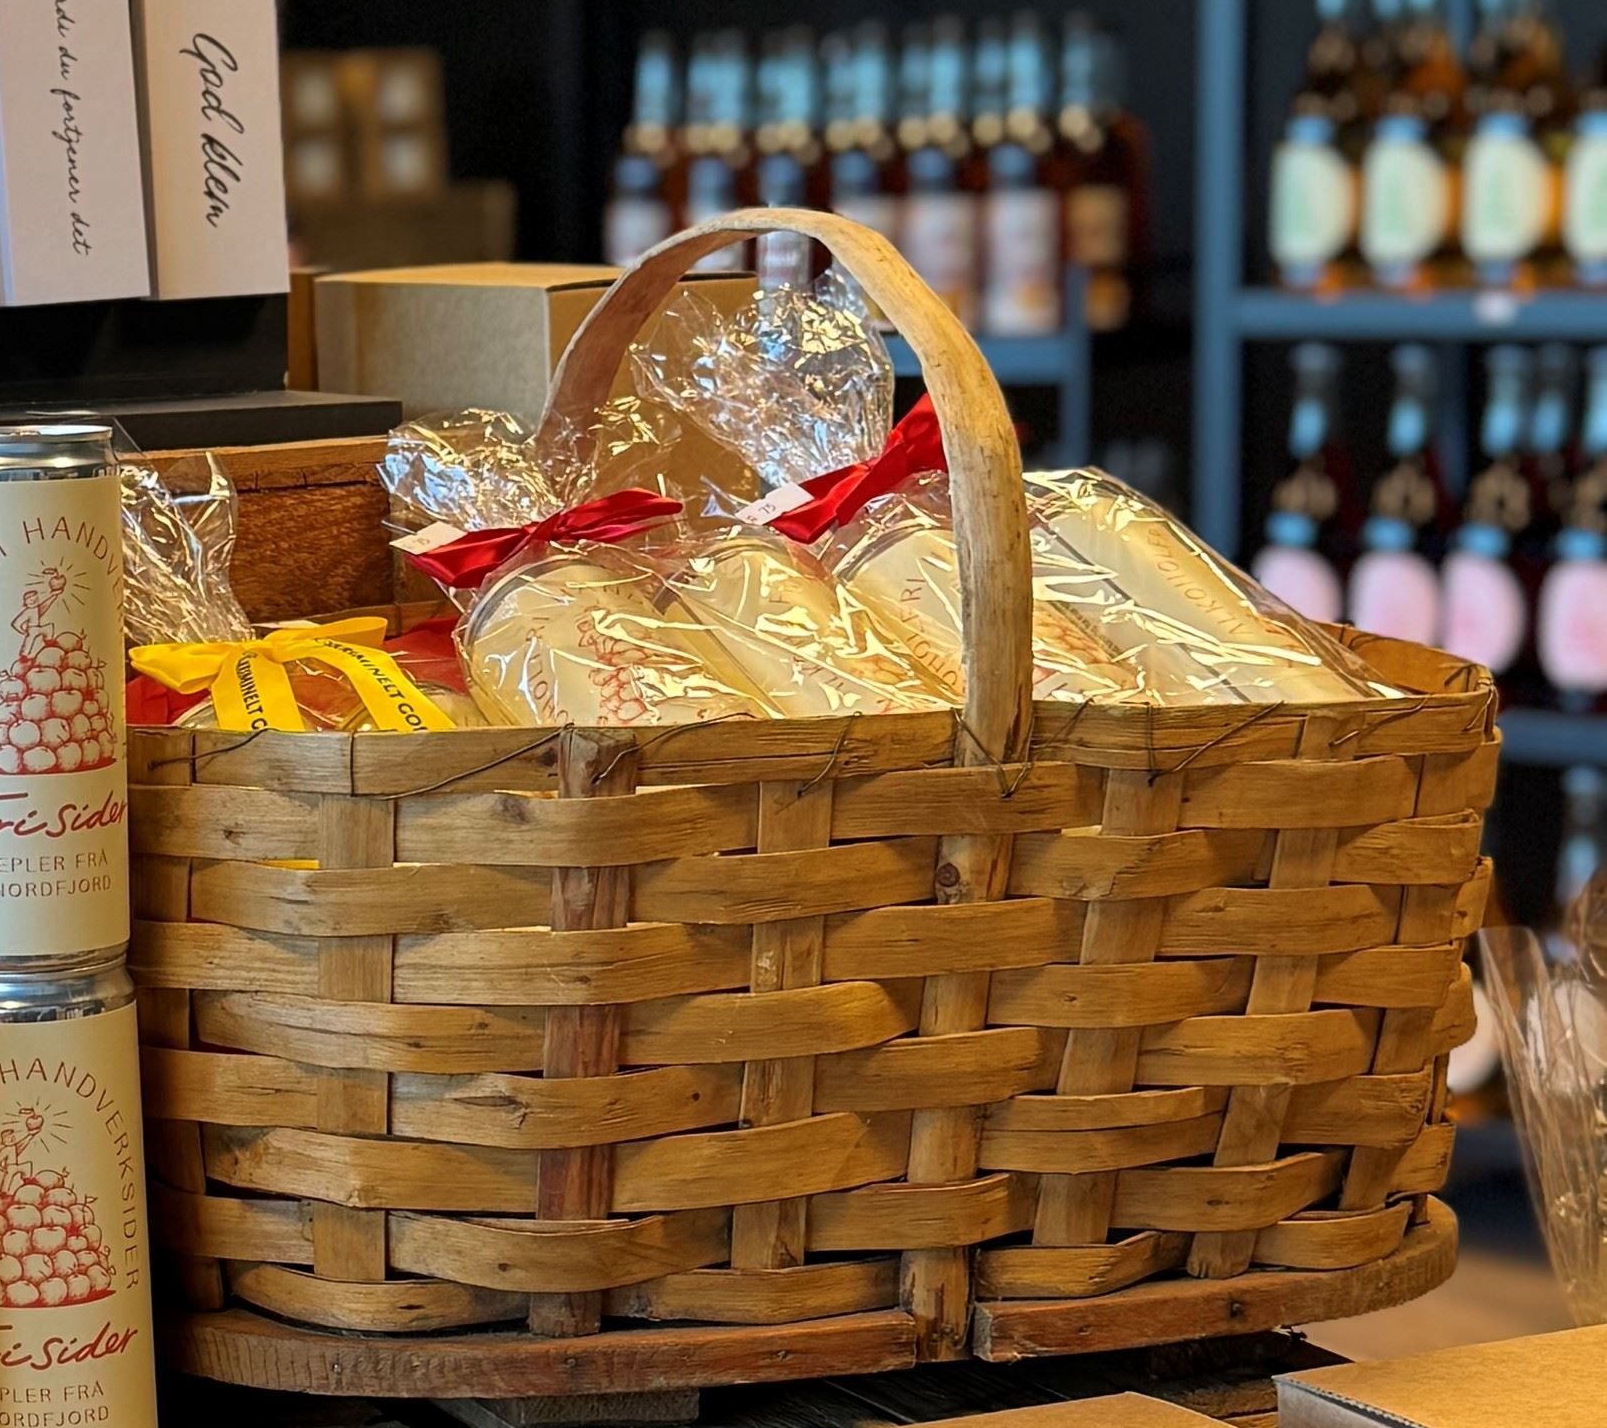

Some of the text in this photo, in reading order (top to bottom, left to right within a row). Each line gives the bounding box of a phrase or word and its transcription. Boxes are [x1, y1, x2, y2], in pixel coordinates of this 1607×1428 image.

[58, 45, 78, 82] du
[49, 86, 85, 204] fortjener
[178, 32, 245, 229] God klem
[71, 211, 92, 258] det
